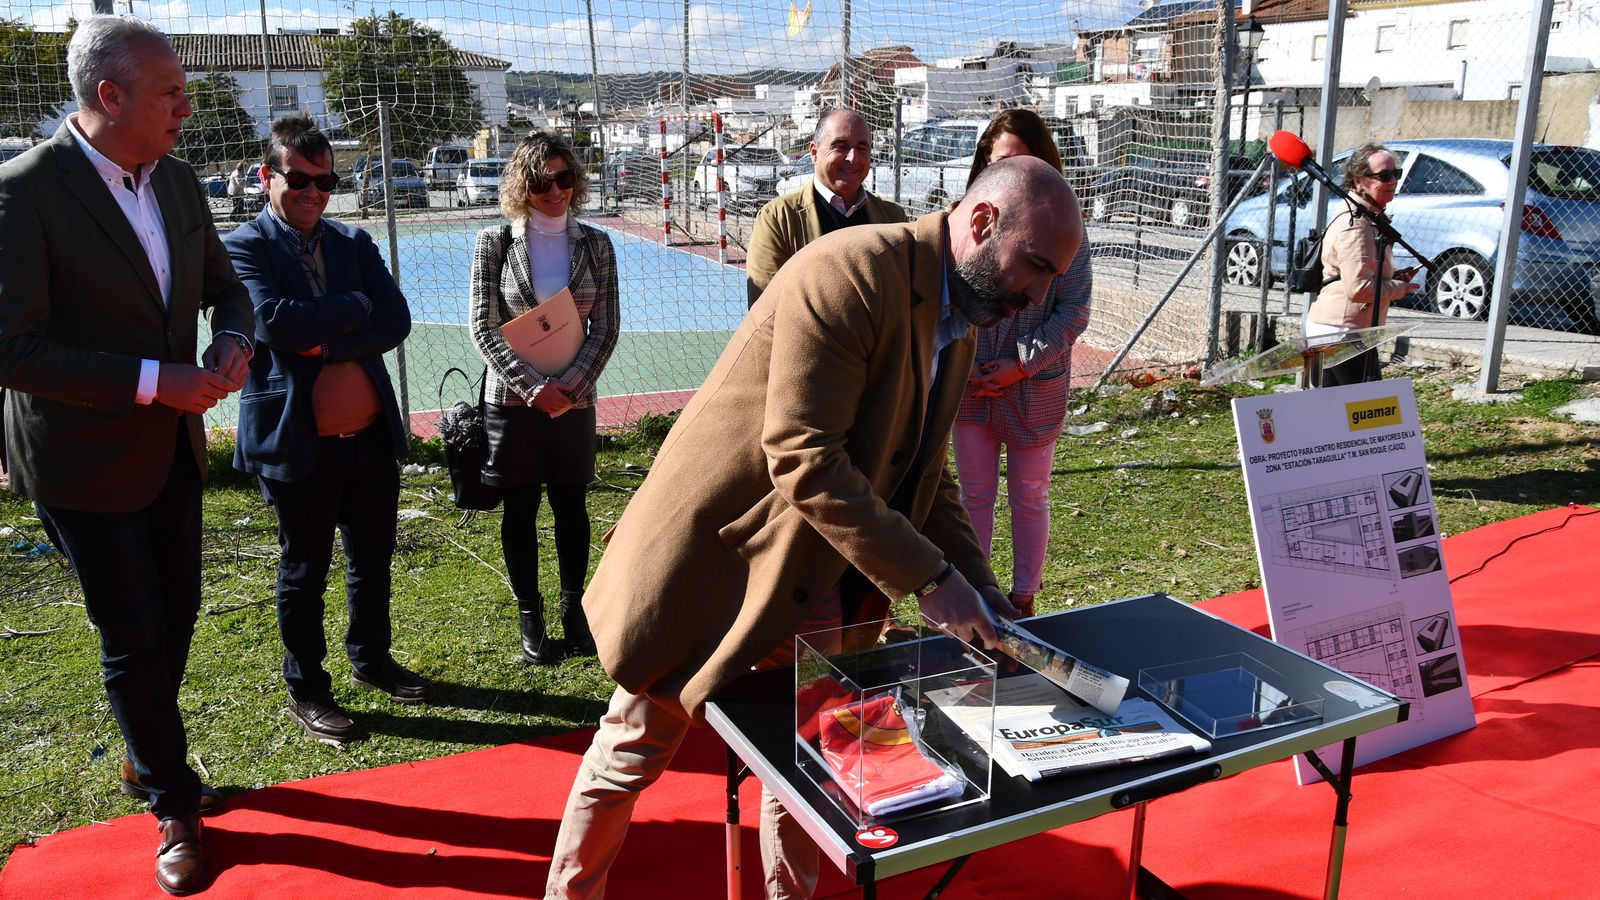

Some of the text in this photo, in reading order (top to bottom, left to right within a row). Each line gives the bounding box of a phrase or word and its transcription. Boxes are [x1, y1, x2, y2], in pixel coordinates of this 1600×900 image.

[1352, 406, 1396, 424] guamar
[1249, 430, 1416, 464] OBRA: PROYECTO PARA CENTRO RESIDENCIAL DE MAYORES EN LA
[1265, 464, 1281, 473] ZONA
[1347, 450, 1358, 459] T.M.
[1358, 448, 1370, 457] SAN
[1370, 445, 1388, 454] ROQUE
[1387, 442, 1406, 453] (CÁDIZ)
[1021, 749, 1059, 758] Heridos
[1109, 738, 1126, 746] dos
